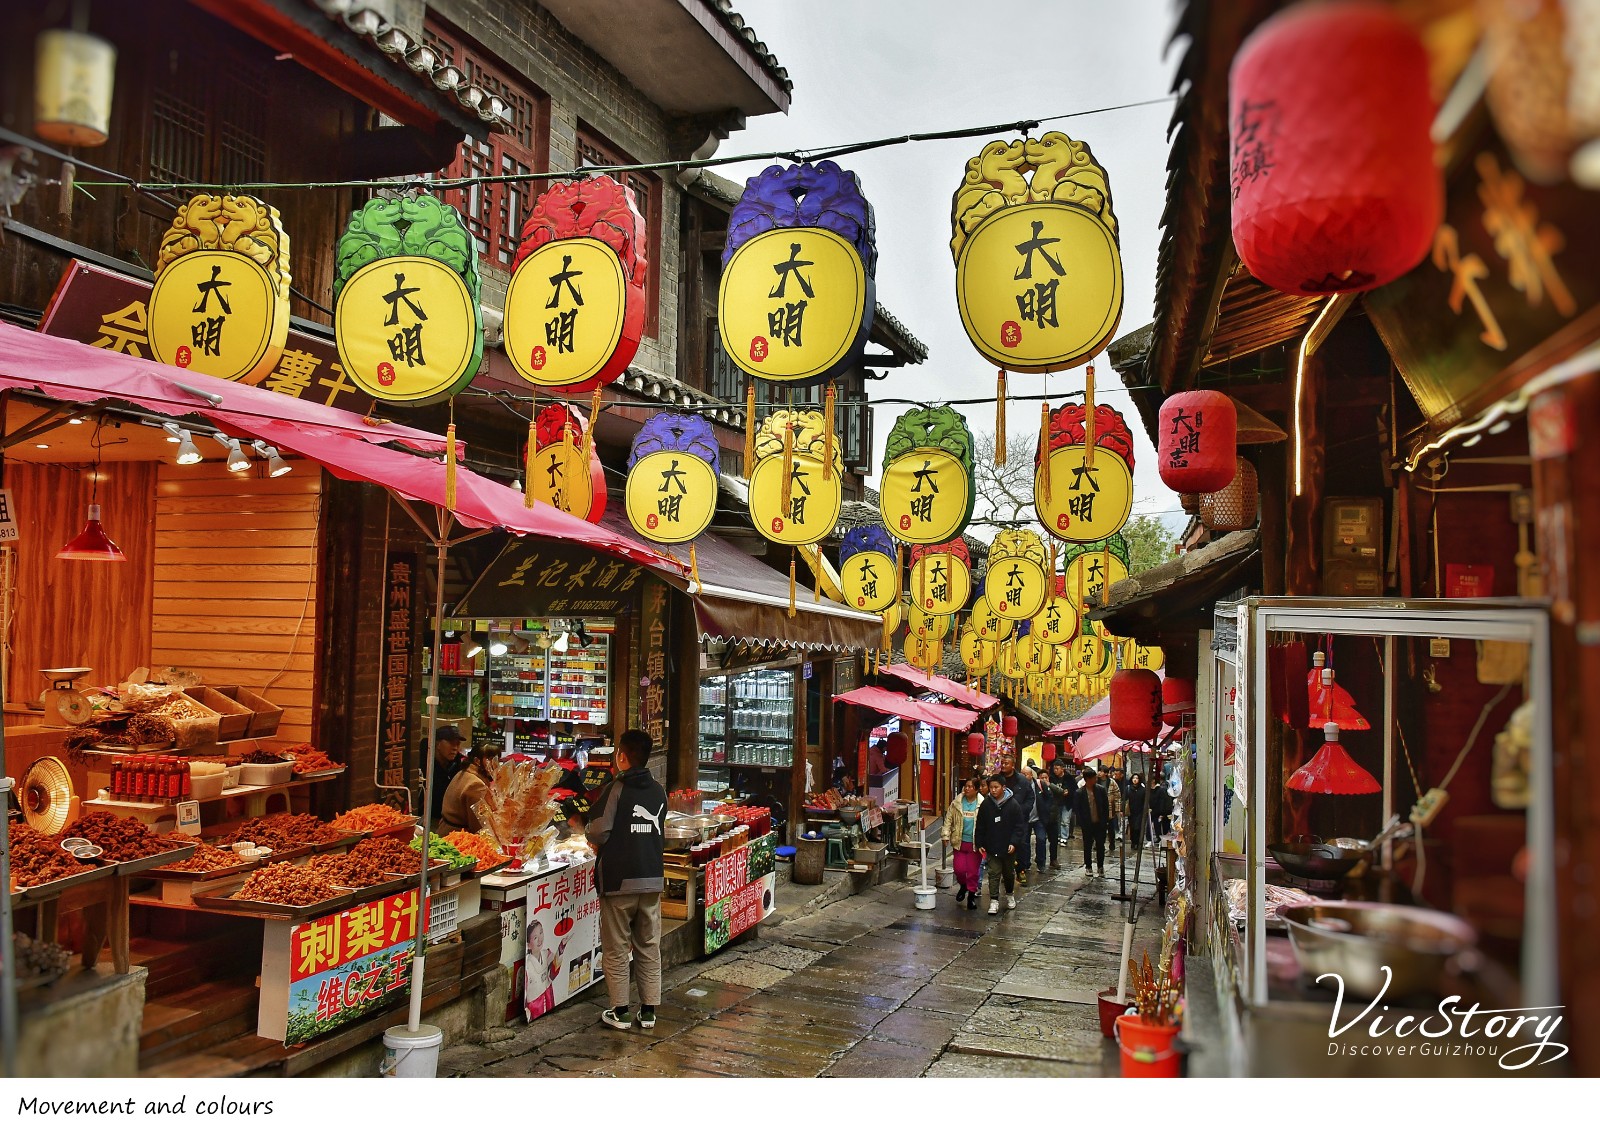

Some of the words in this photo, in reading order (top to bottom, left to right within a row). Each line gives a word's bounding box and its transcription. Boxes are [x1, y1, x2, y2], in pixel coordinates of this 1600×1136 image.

[545, 255, 584, 354] 大明
[768, 243, 815, 347] 大明
[1014, 221, 1067, 329] 大明
[191, 265, 232, 356] 大明
[382, 273, 428, 368] 大明
[1169, 408, 1200, 469] 大明志
[658, 460, 687, 522] 大明
[910, 460, 939, 522] 大明
[1069, 456, 1100, 522] 大明
[0, 528, 15, 538] 813
[860, 559, 878, 599] 大明
[930, 561, 947, 602] 大明
[1006, 564, 1025, 606] 大明
[1046, 602, 1061, 633] 大明
[1081, 640, 1094, 667] 大明
[630, 823, 652, 833] PUMA
[297, 891, 418, 974] 刺梨汁
[316, 951, 408, 1022] 维C之王
